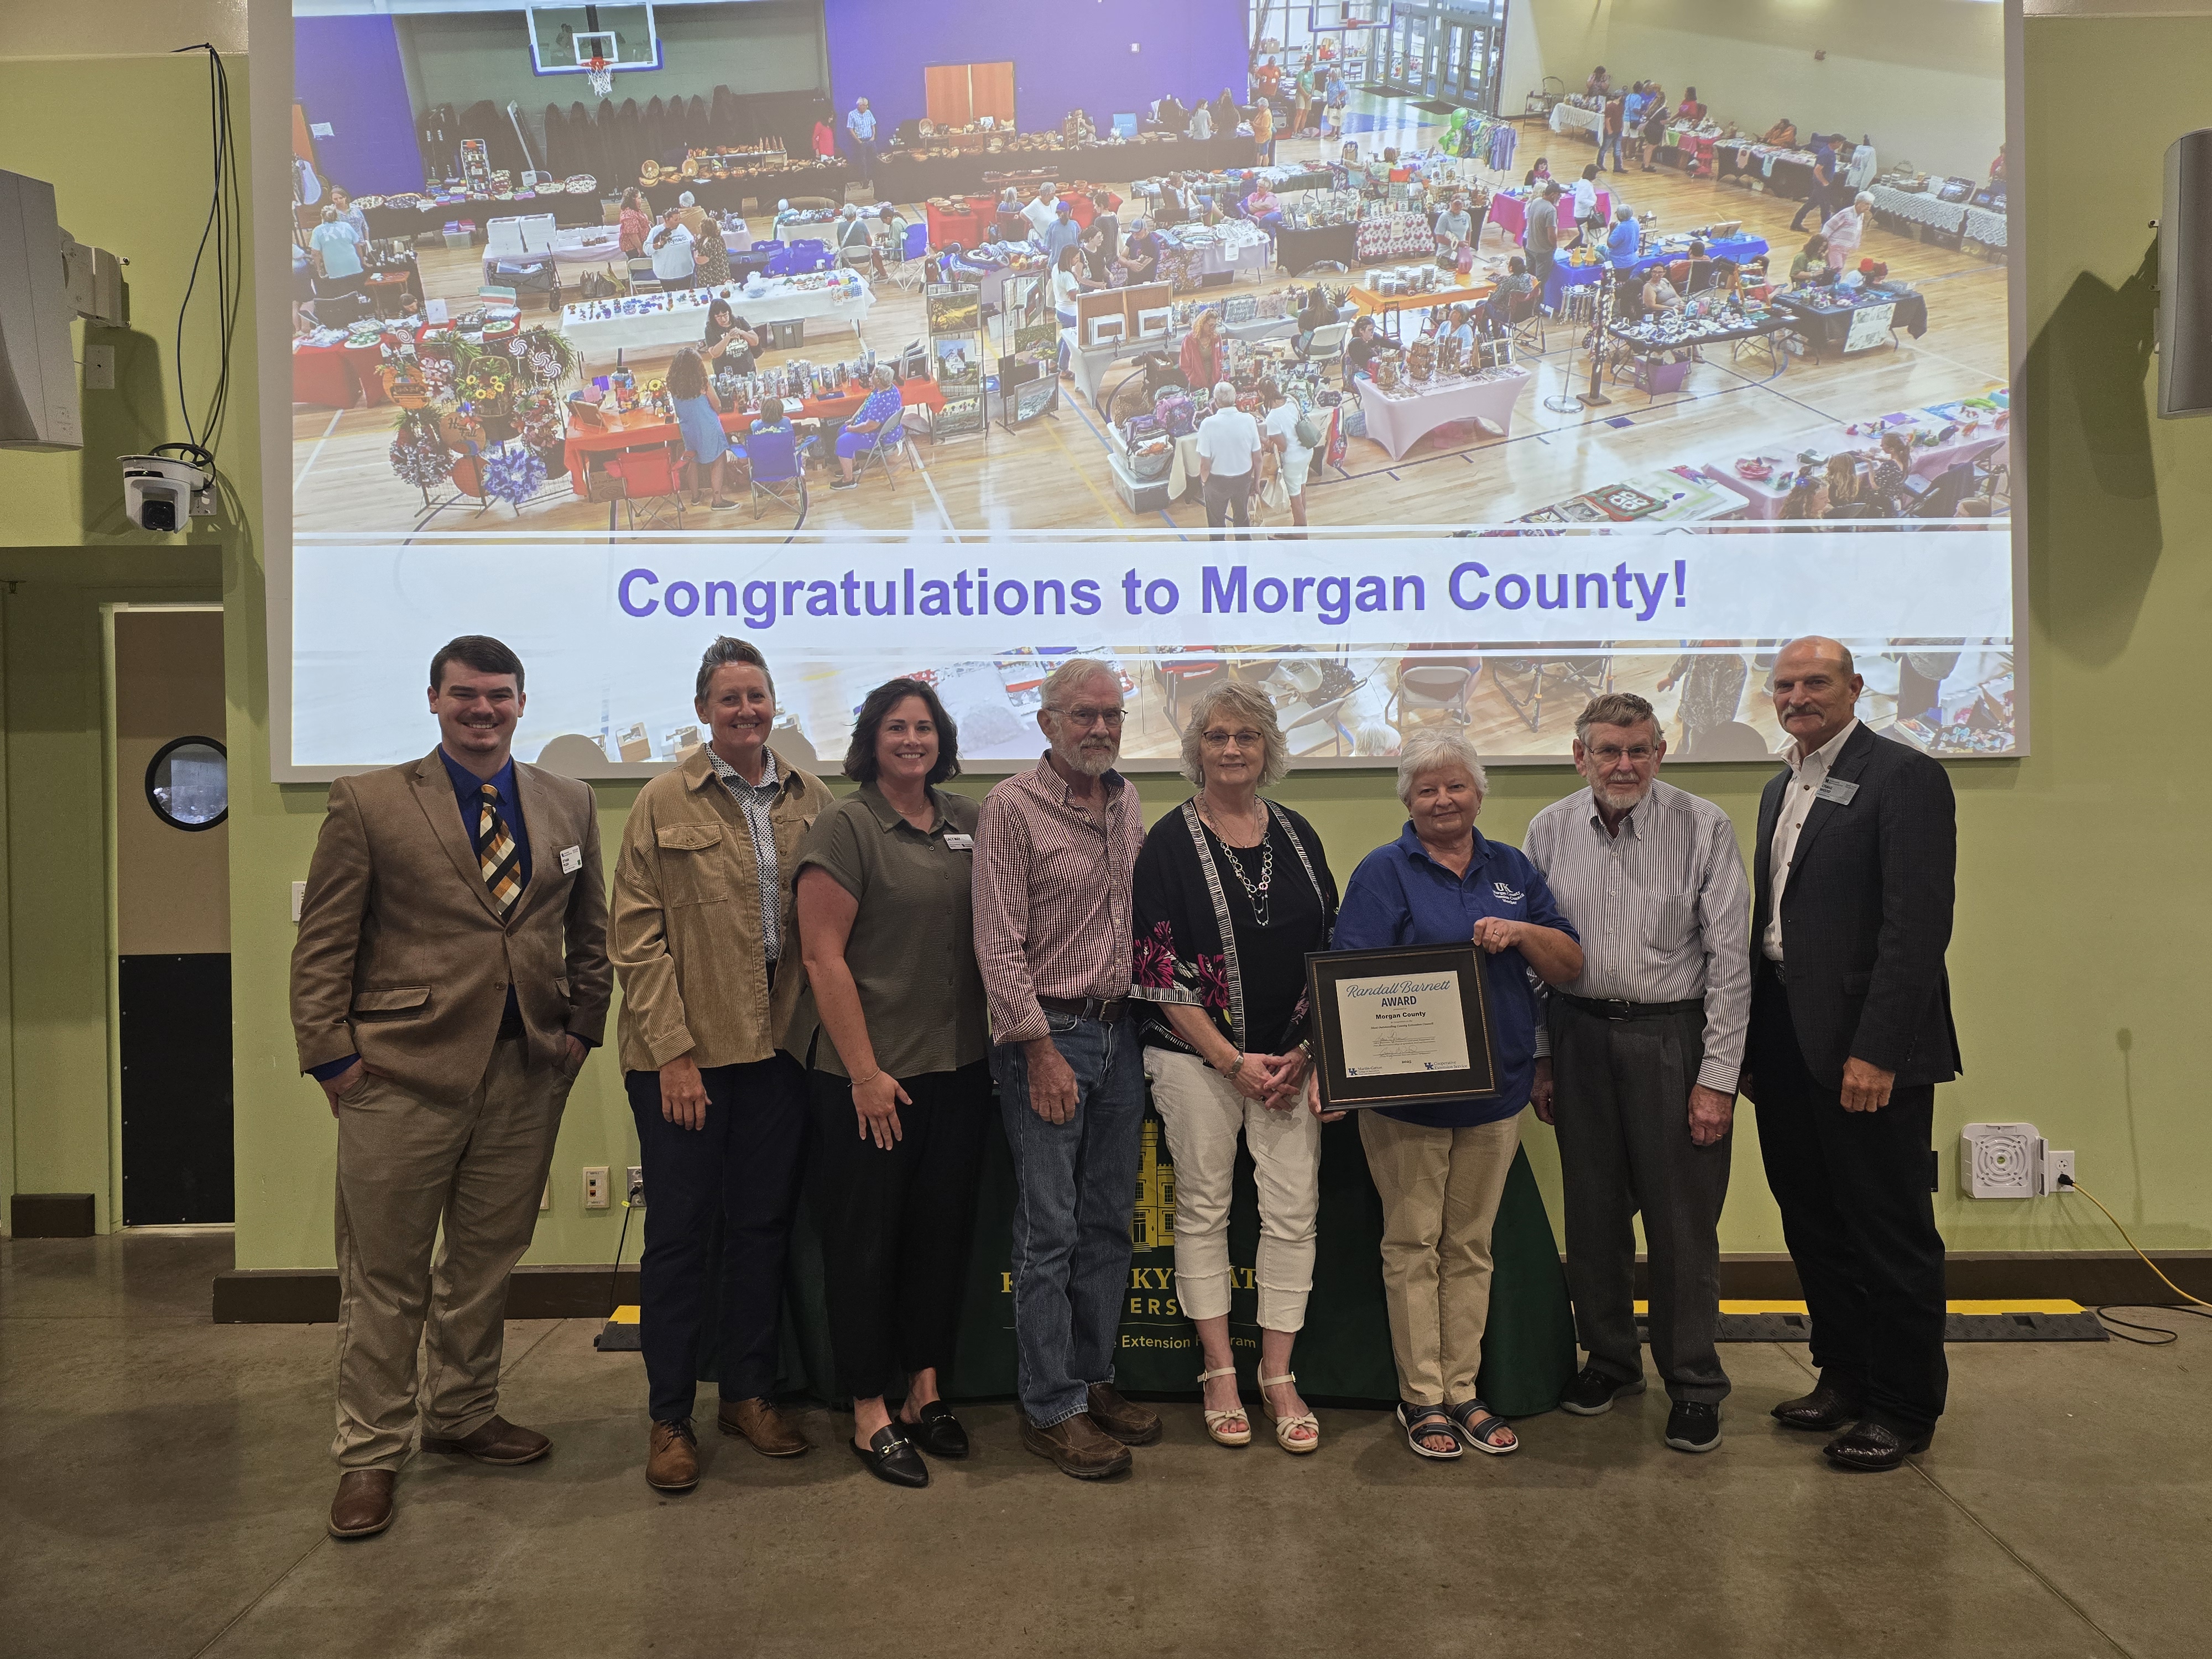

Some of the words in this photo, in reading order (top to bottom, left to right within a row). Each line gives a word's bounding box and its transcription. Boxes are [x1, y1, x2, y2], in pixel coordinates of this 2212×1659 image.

[619, 568, 1102, 629] Congratulations
[1123, 569, 1180, 615] to
[1203, 566, 1425, 625] Morgan
[1450, 560, 1687, 622] County!
[1494, 882, 1513, 893] UK
[1346, 983, 1400, 998] Randall
[1400, 980, 1451, 994] Barnett
[1381, 995, 1417, 1007] AWARD
[1348, 1068, 1358, 1076] UK
[1423, 1062, 1434, 1070] UK
[1122, 1334, 1190, 1349] Extension
[1196, 1334, 1256, 1349] Pram
